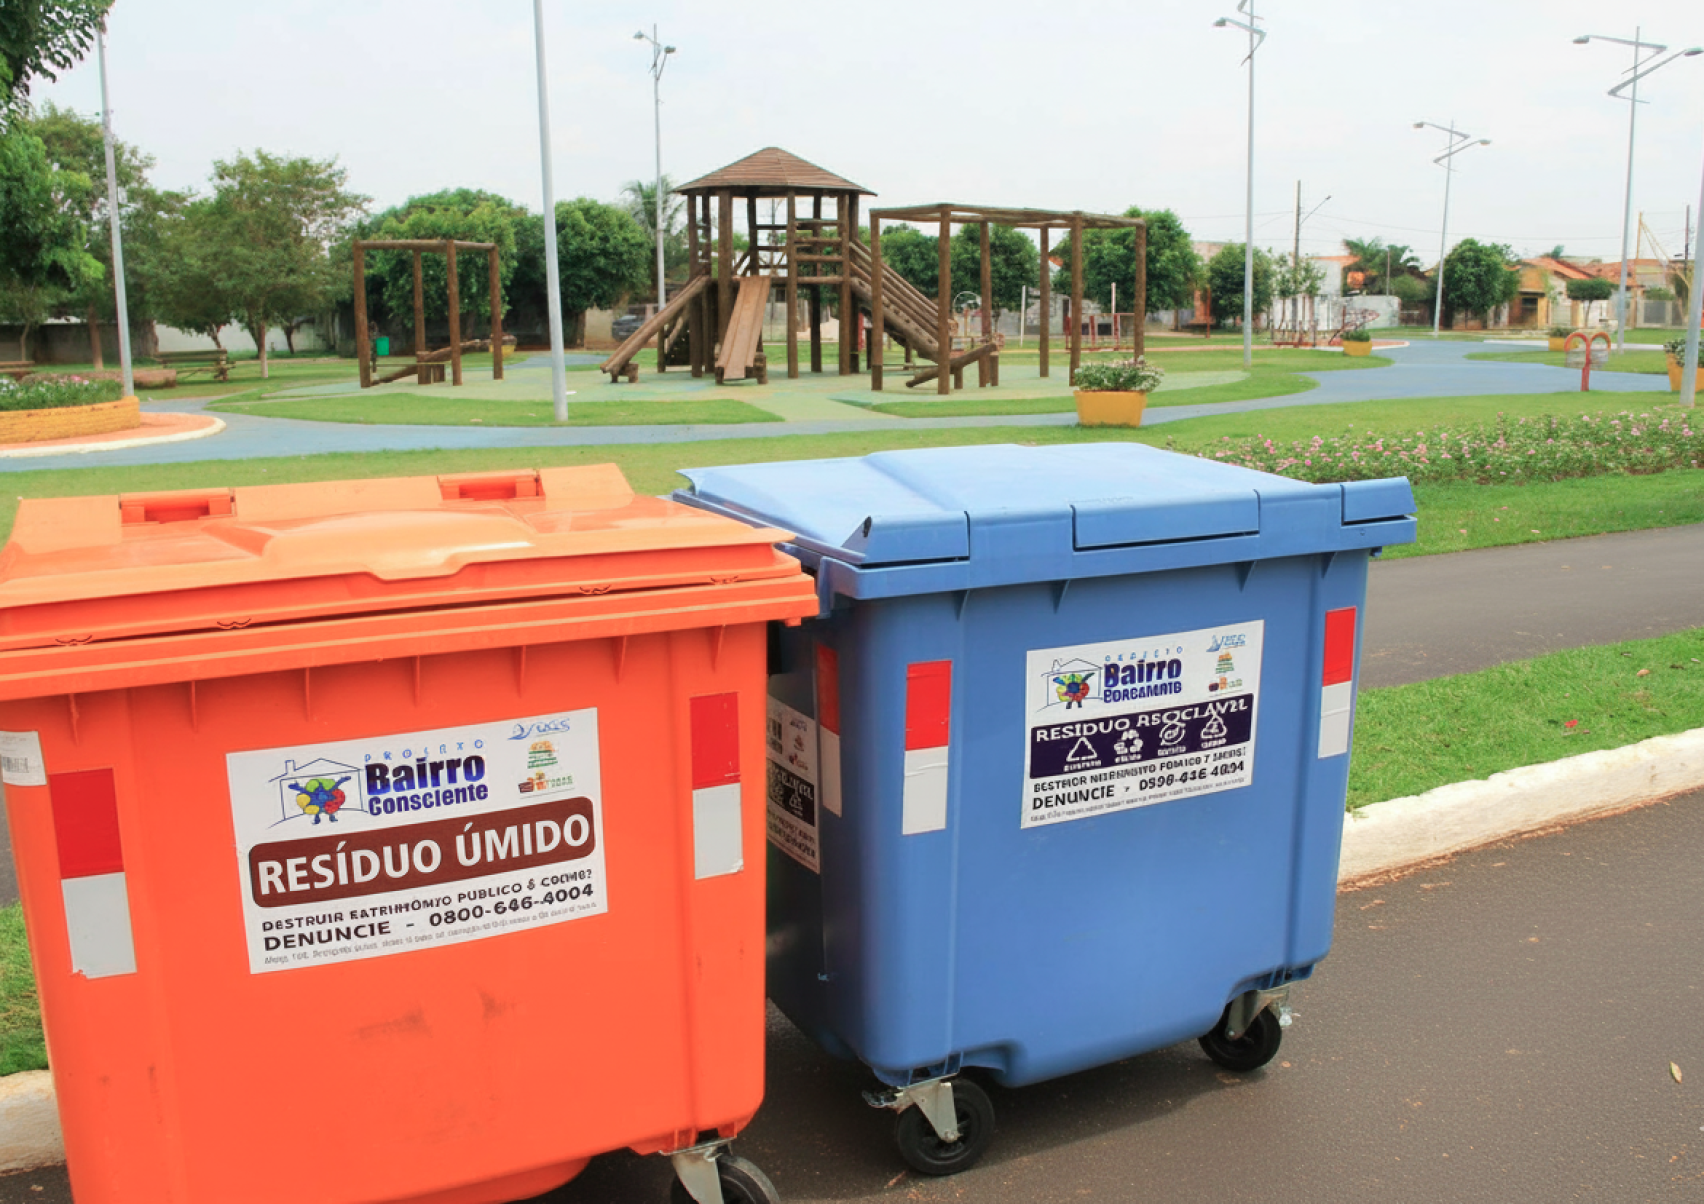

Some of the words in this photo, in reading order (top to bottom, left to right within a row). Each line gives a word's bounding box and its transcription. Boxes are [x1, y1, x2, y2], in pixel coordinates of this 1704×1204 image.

[1104, 658, 1182, 687] Bairro
[1036, 718, 1130, 741] RESIDUO
[365, 755, 485, 796] Bairro
[369, 784, 488, 816] Consciente
[1033, 785, 1115, 810] DENUNCIE
[258, 839, 442, 895] RESÍDUO
[456, 814, 590, 866] ÚMIDO
[458, 883, 522, 903] PUBLICO
[264, 921, 391, 951] DENUNCIE
[429, 883, 594, 926] 0800-646-4004
